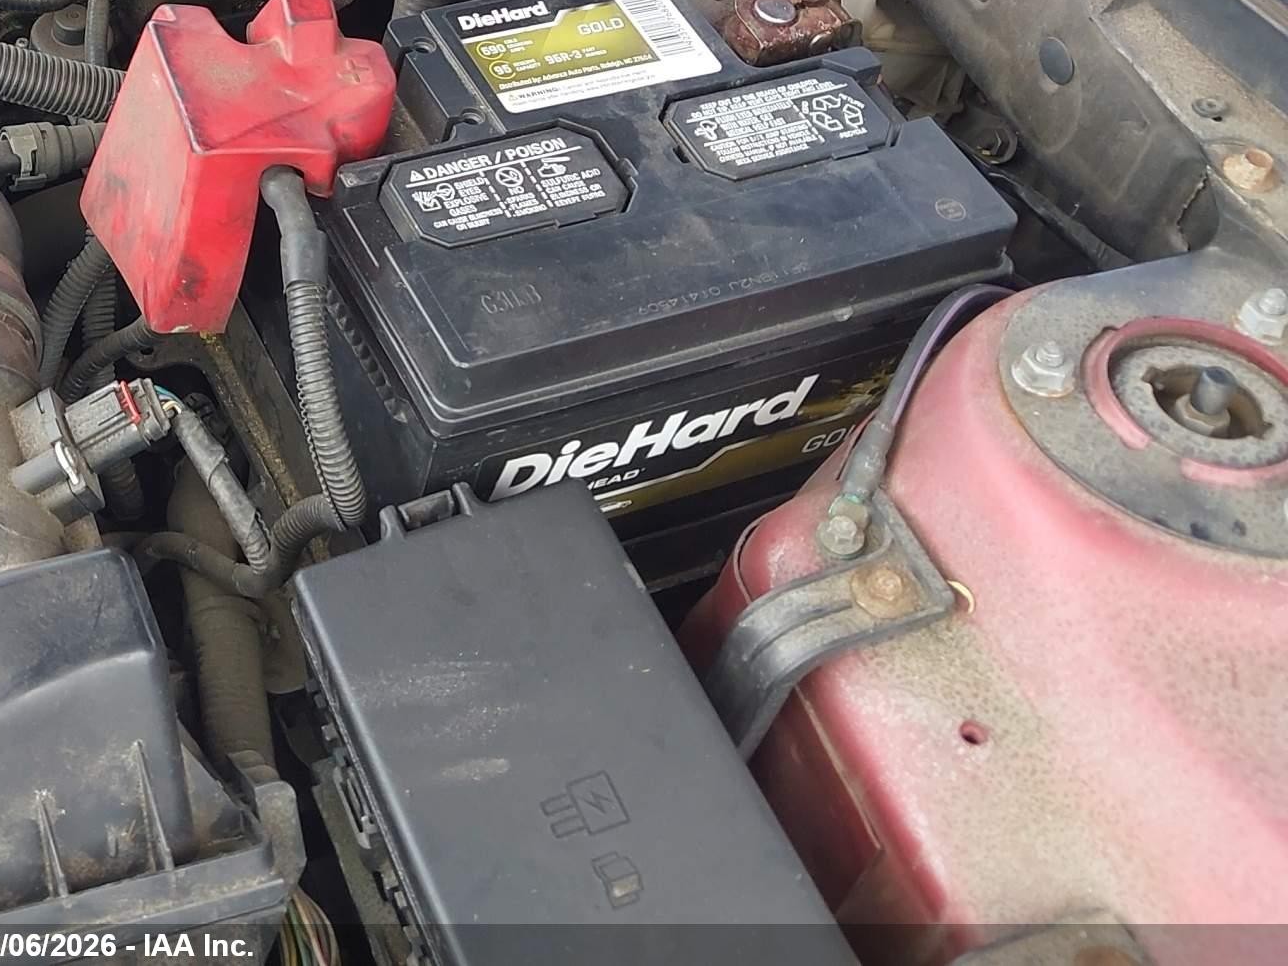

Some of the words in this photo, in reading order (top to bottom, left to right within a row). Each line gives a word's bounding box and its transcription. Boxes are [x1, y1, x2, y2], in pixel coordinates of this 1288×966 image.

[457, 1, 550, 32] DieHard
[577, 17, 625, 35] GOLD
[423, 156, 492, 180] DANGER
[493, 151, 502, 165] /
[504, 138, 567, 160] POISON
[454, 177, 484, 190] SHIELD
[540, 173, 581, 188] SULFURIC
[580, 168, 601, 179] ACID
[458, 186, 482, 197] EYES
[508, 186, 524, 195] NO
[545, 185, 562, 194] CAN
[443, 192, 489, 209] EXPLOSIVE
[449, 204, 477, 217] GASES
[489, 374, 820, 502] DieHard
